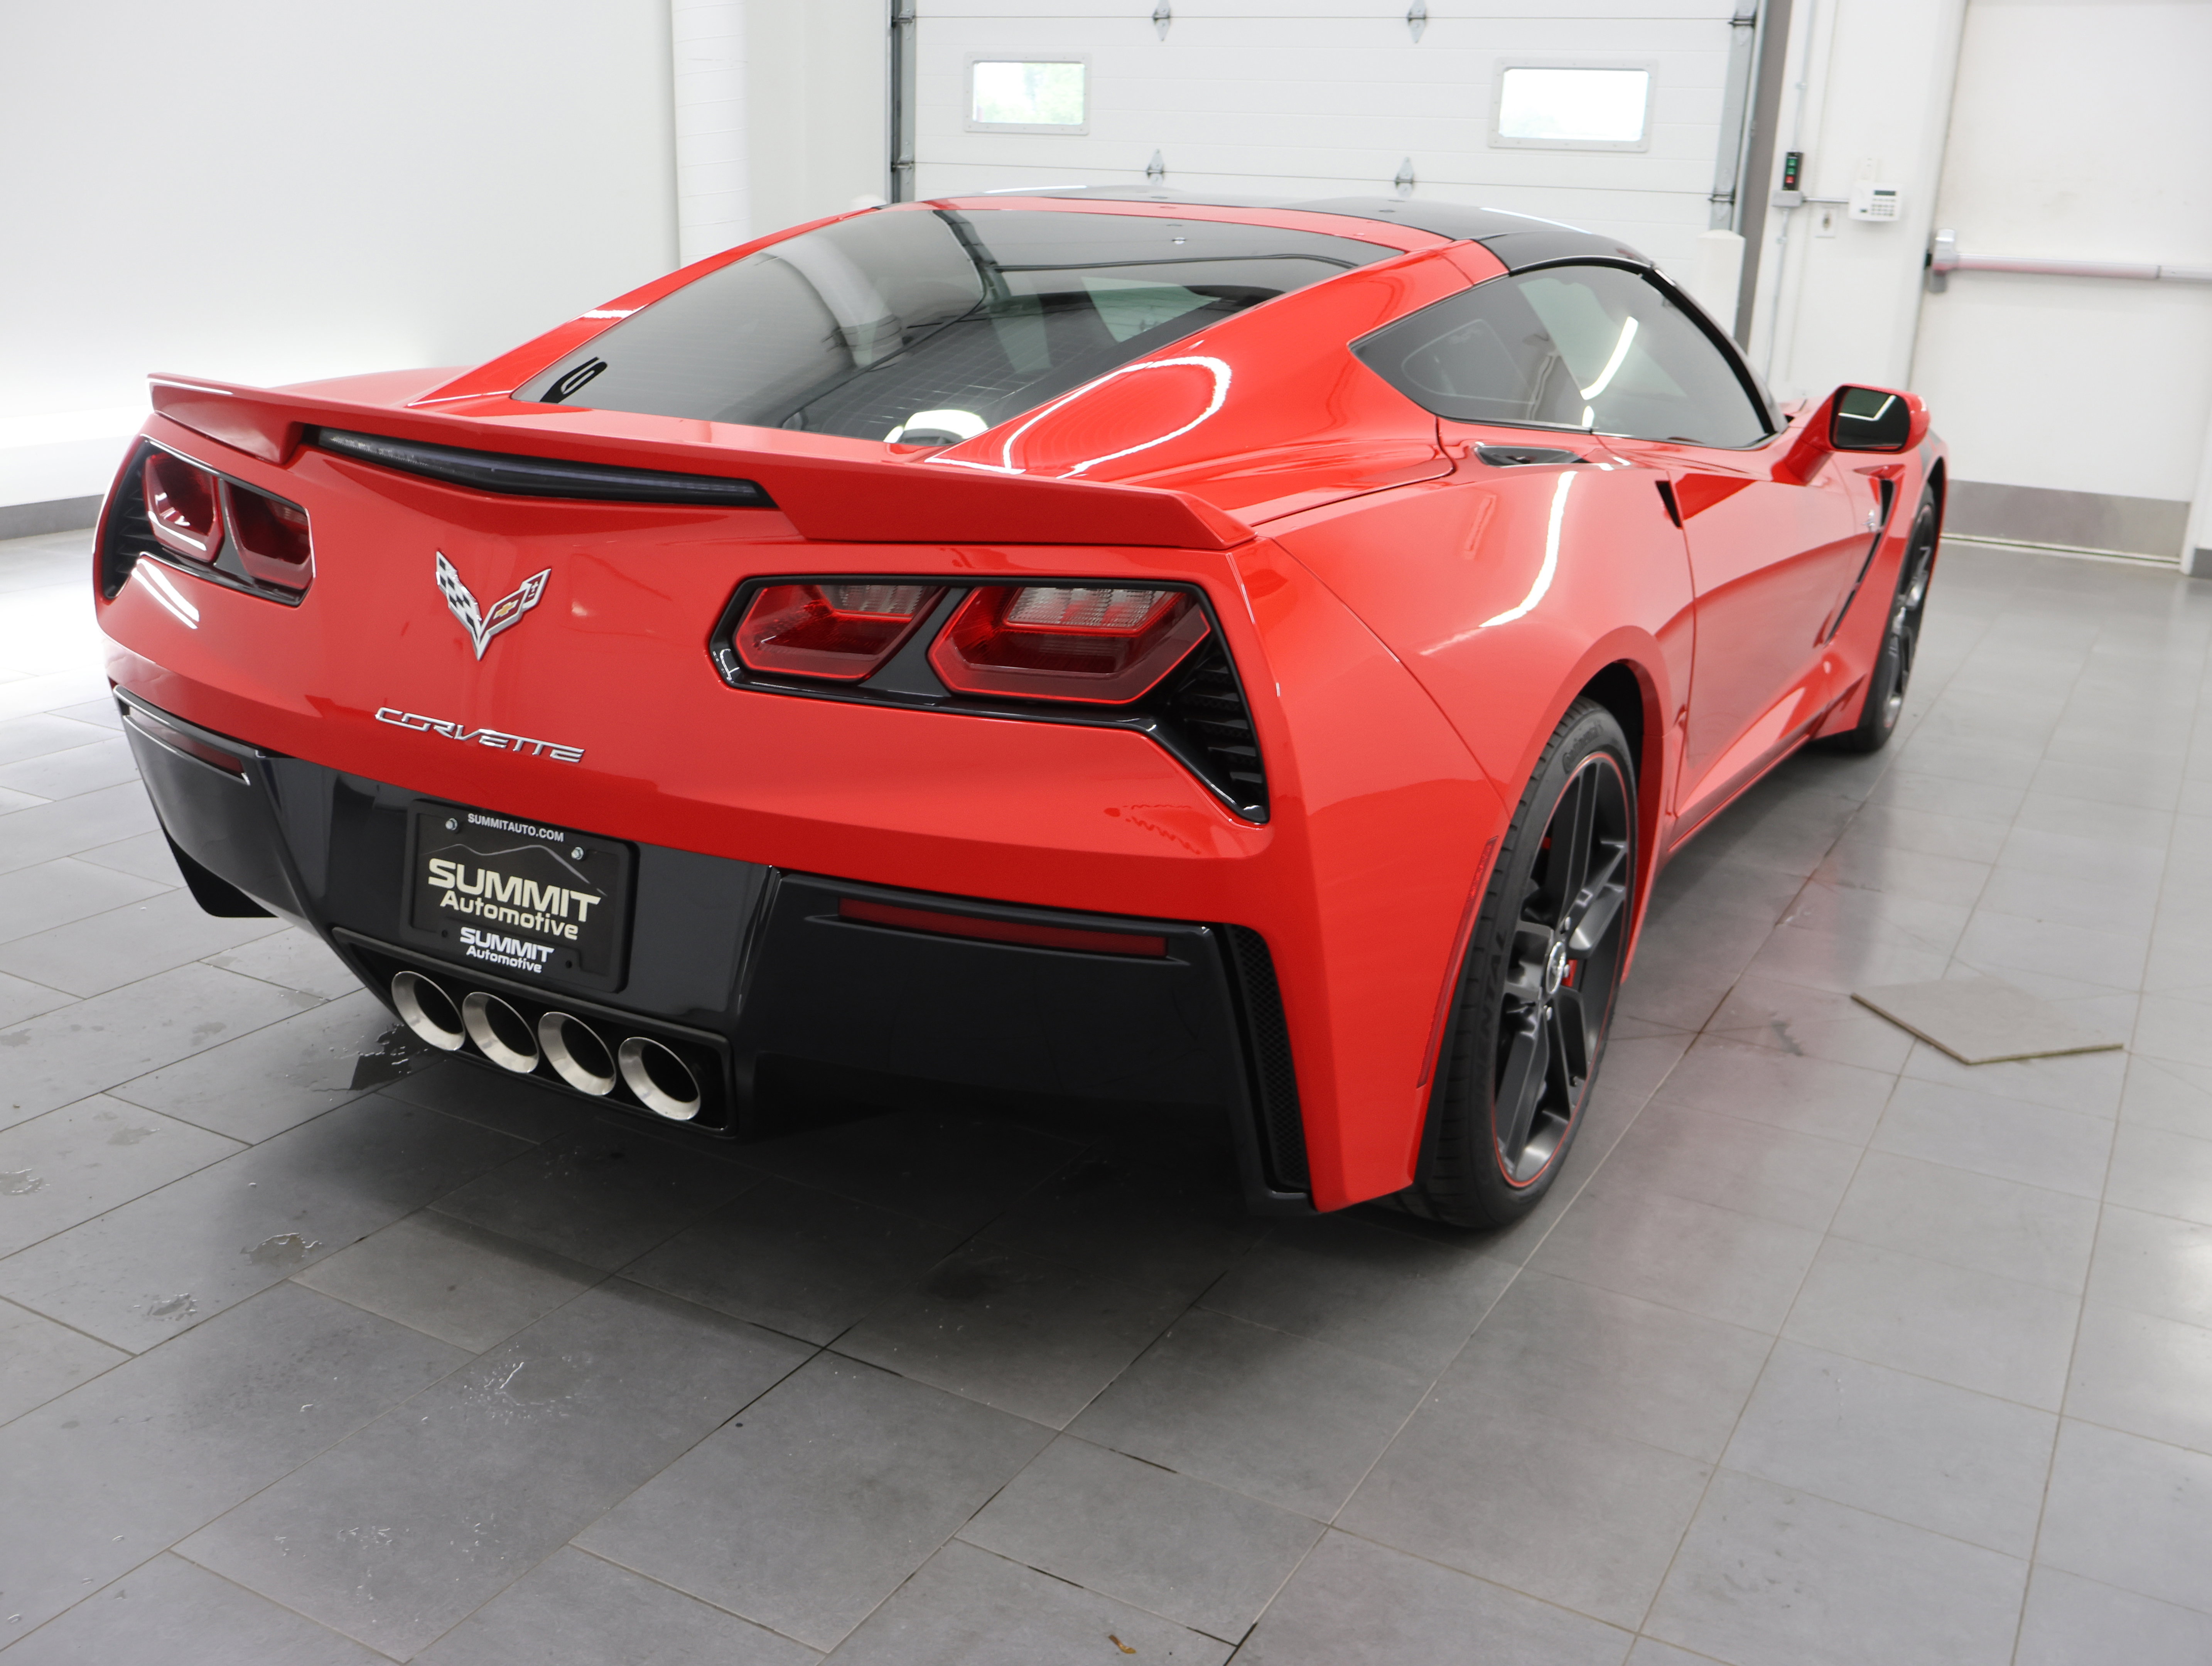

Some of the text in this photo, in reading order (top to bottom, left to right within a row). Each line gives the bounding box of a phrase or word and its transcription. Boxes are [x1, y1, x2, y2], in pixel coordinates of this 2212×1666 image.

[375, 707, 585, 763] CORVETTE
[468, 813, 564, 842] SUMMITAUTO.COM
[429, 858, 601, 922] SUMMIT
[440, 888, 578, 940] Automotive
[460, 927, 554, 962] SUMMIT
[466, 946, 542, 973] Automotive
